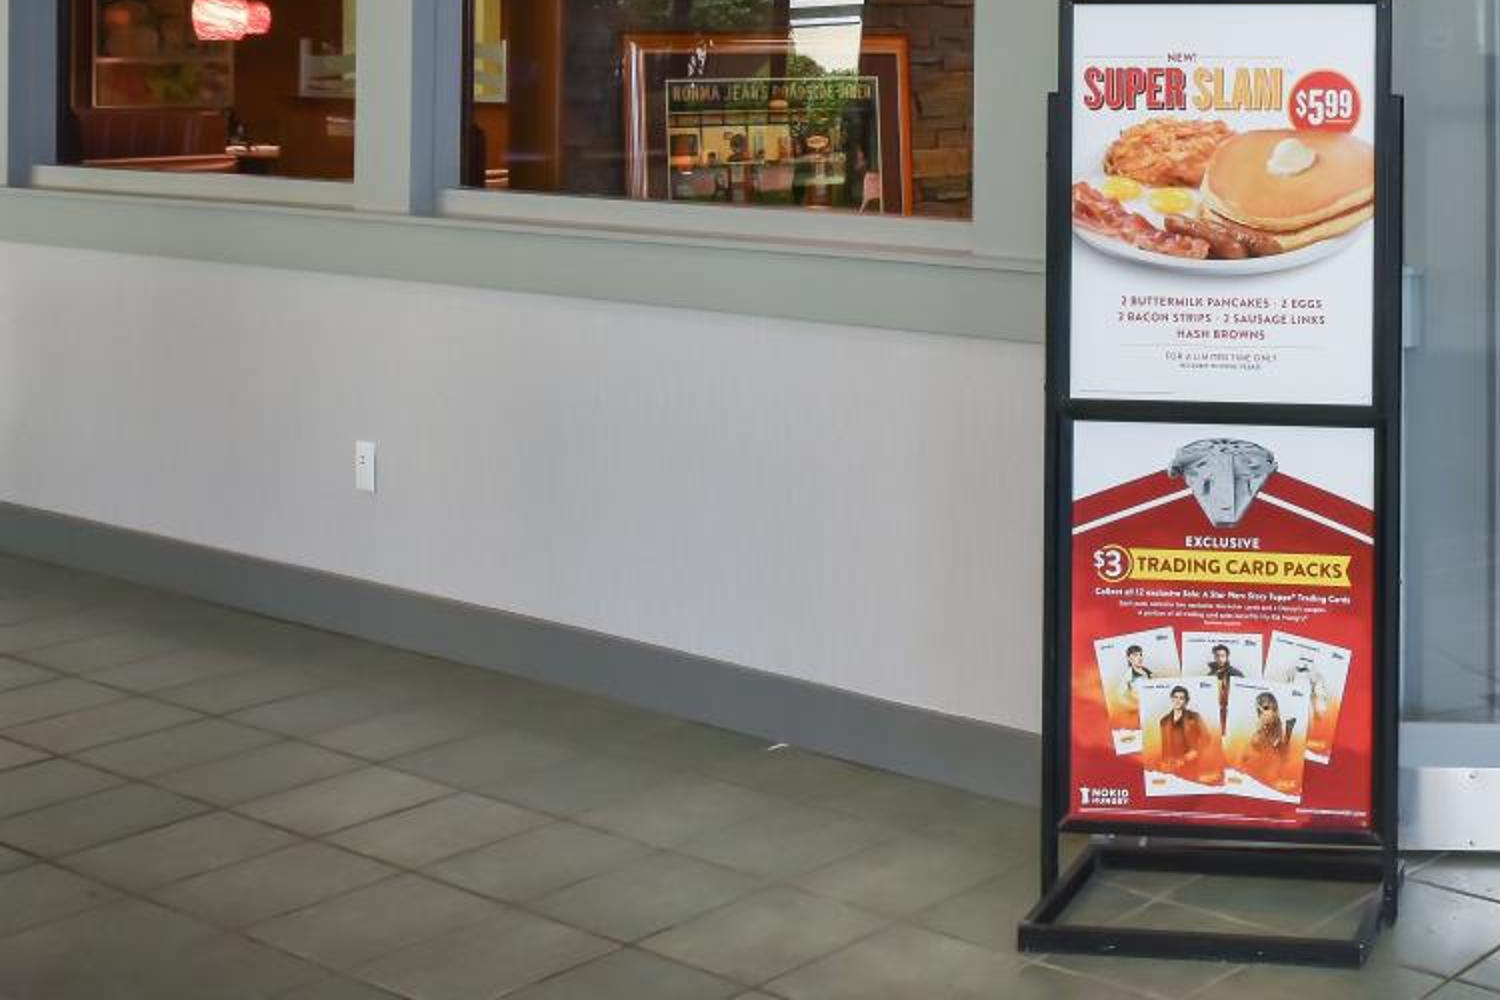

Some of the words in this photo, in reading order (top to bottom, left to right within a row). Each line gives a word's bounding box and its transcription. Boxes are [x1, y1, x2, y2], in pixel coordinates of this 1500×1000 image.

[1083, 66, 1187, 111] SUPER
[1193, 67, 1283, 112] SLAM
[1121, 296, 1127, 307] 2
[1130, 296, 1204, 308] BUTTERMILK
[1207, 297, 1270, 309] PANCAKES
[1281, 299, 1287, 309] 2
[1291, 299, 1322, 310] EGGS
[1118, 312, 1124, 321] 2
[1127, 312, 1169, 323] BACON
[1173, 313, 1212, 324] STRIPS
[1223, 313, 1229, 324] 2
[1233, 314, 1287, 325] SAUSAGE
[1291, 314, 1326, 325] LINKS
[1177, 329, 1210, 340] HASH
[1213, 330, 1265, 341] BROWNS
[1185, 535, 1261, 549] EXCLUSIVE
[1093, 550, 1121, 577] $3
[1137, 556, 1221, 575] TRADING
[1225, 559, 1279, 577] CARD
[1284, 562, 1342, 579] PACKS
